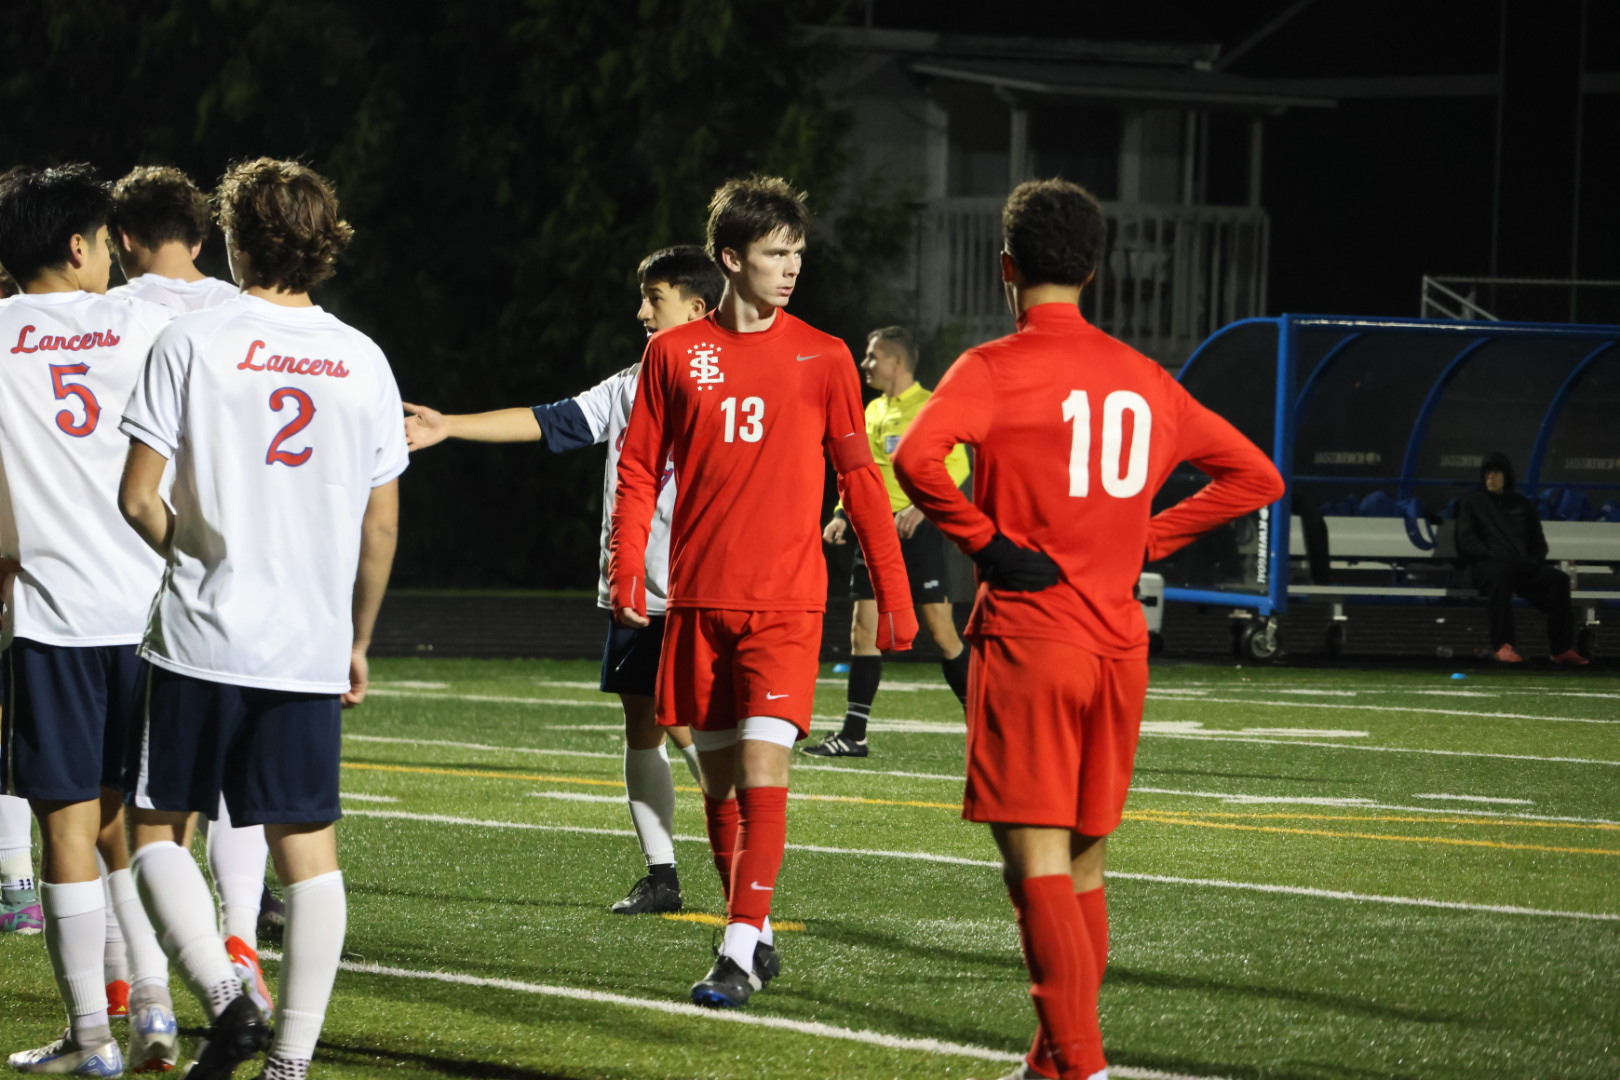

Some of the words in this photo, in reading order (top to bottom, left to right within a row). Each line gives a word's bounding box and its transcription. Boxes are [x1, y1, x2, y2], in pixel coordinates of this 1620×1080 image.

[11, 325, 120, 354] Lancers
[237, 340, 349, 378] Lancers
[49, 362, 102, 438] 5
[266, 386, 317, 467] 2
[721, 397, 764, 443] 13
[1062, 389, 1152, 498] 10
